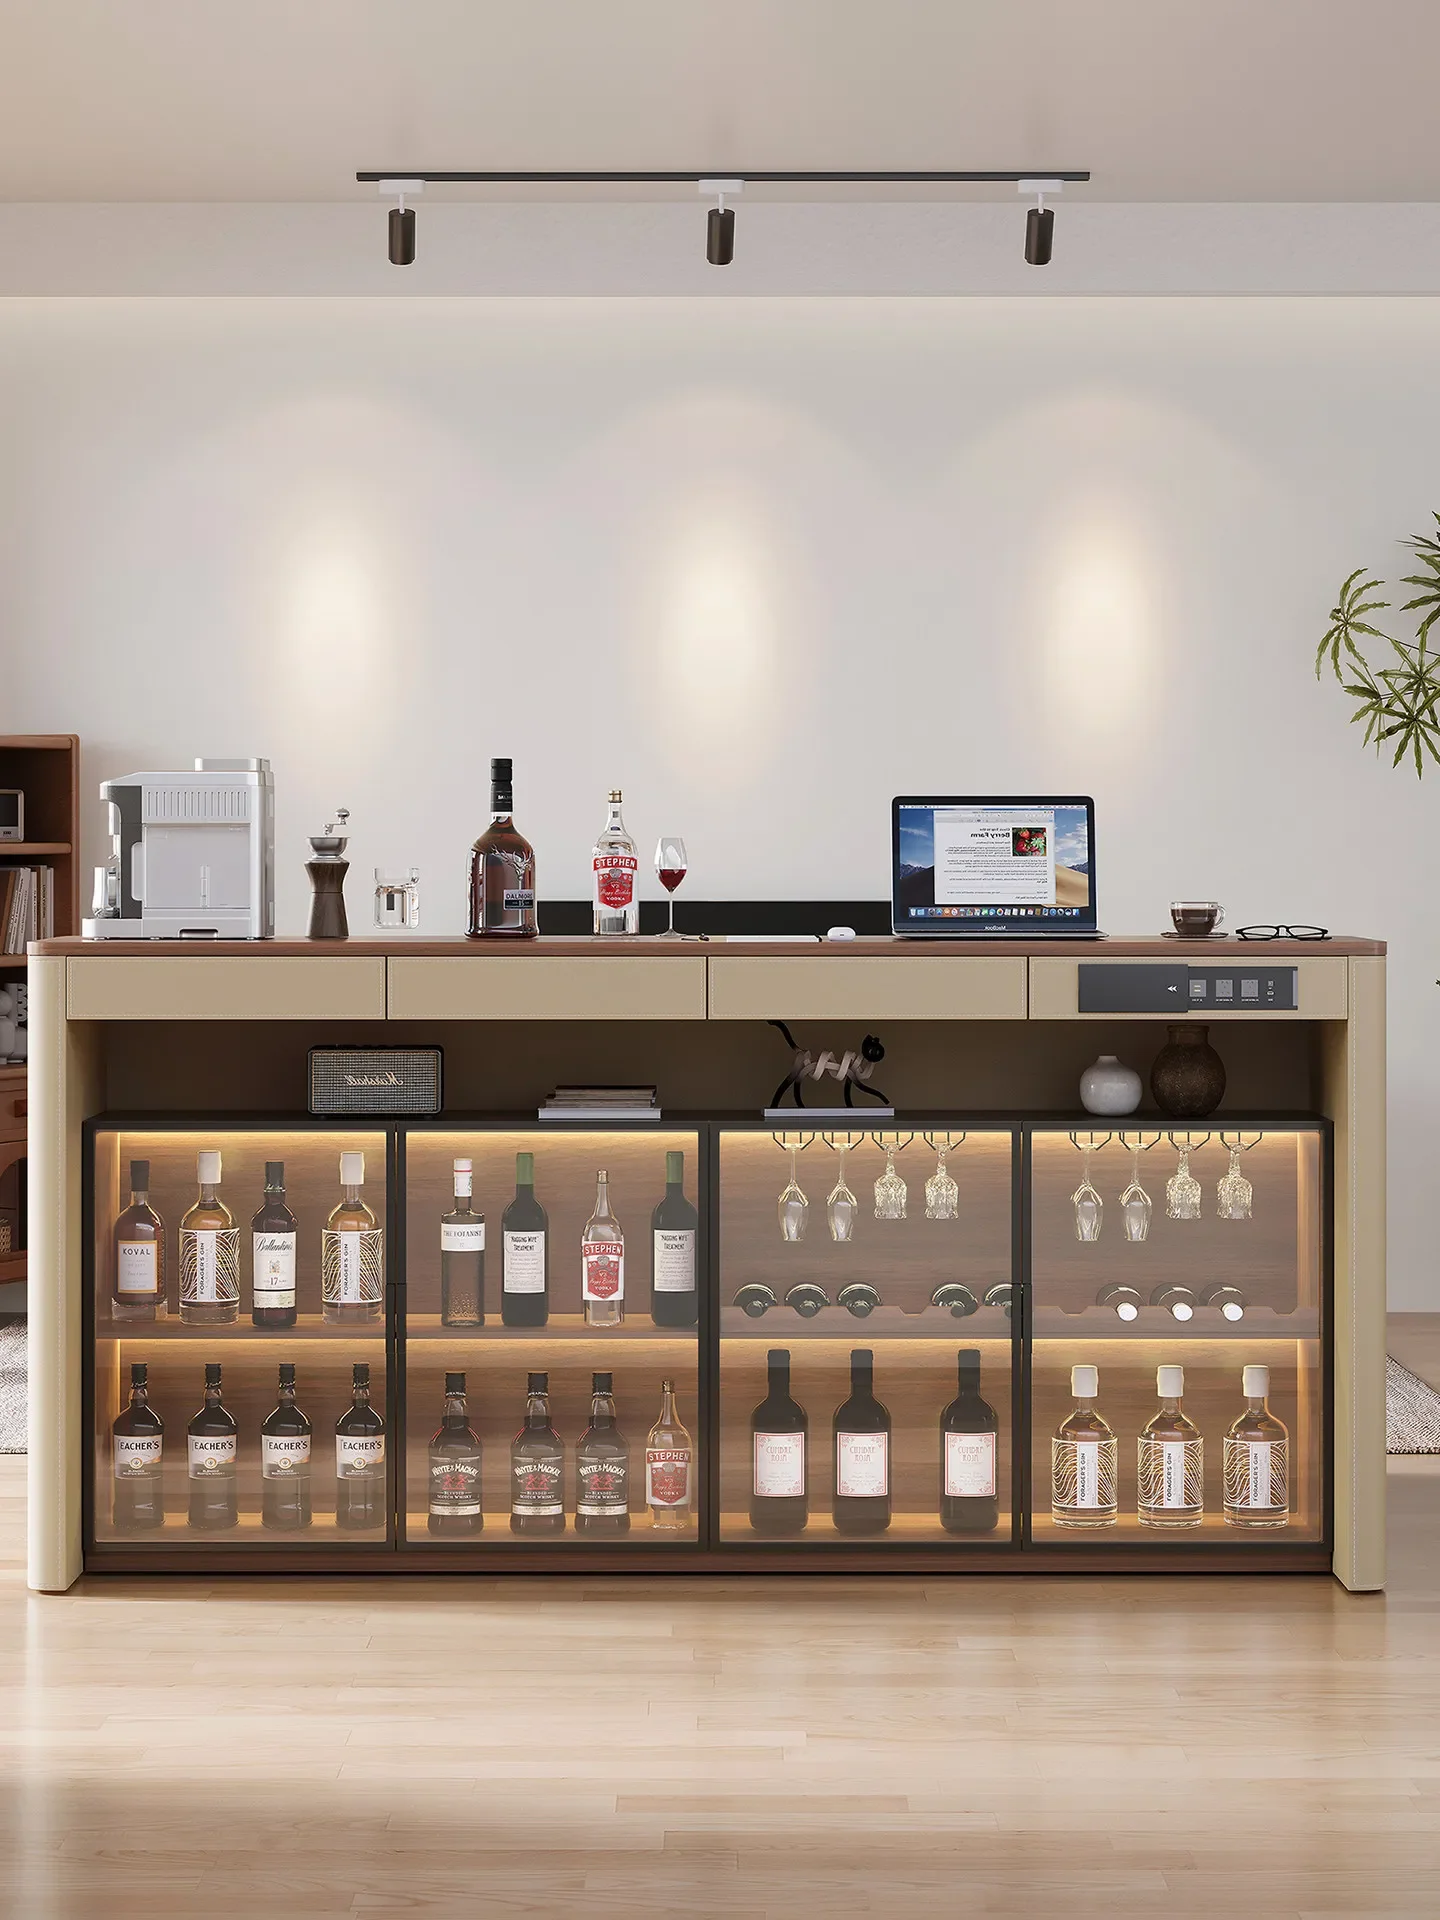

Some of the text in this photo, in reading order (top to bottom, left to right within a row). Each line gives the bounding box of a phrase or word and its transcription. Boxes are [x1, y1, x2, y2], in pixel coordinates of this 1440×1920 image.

[596, 857, 636, 868] STEPHEN
[584, 1245, 622, 1255] STEPHEN
[269, 1277, 278, 1286] 17
[648, 1452, 689, 1461] STEPHEN
